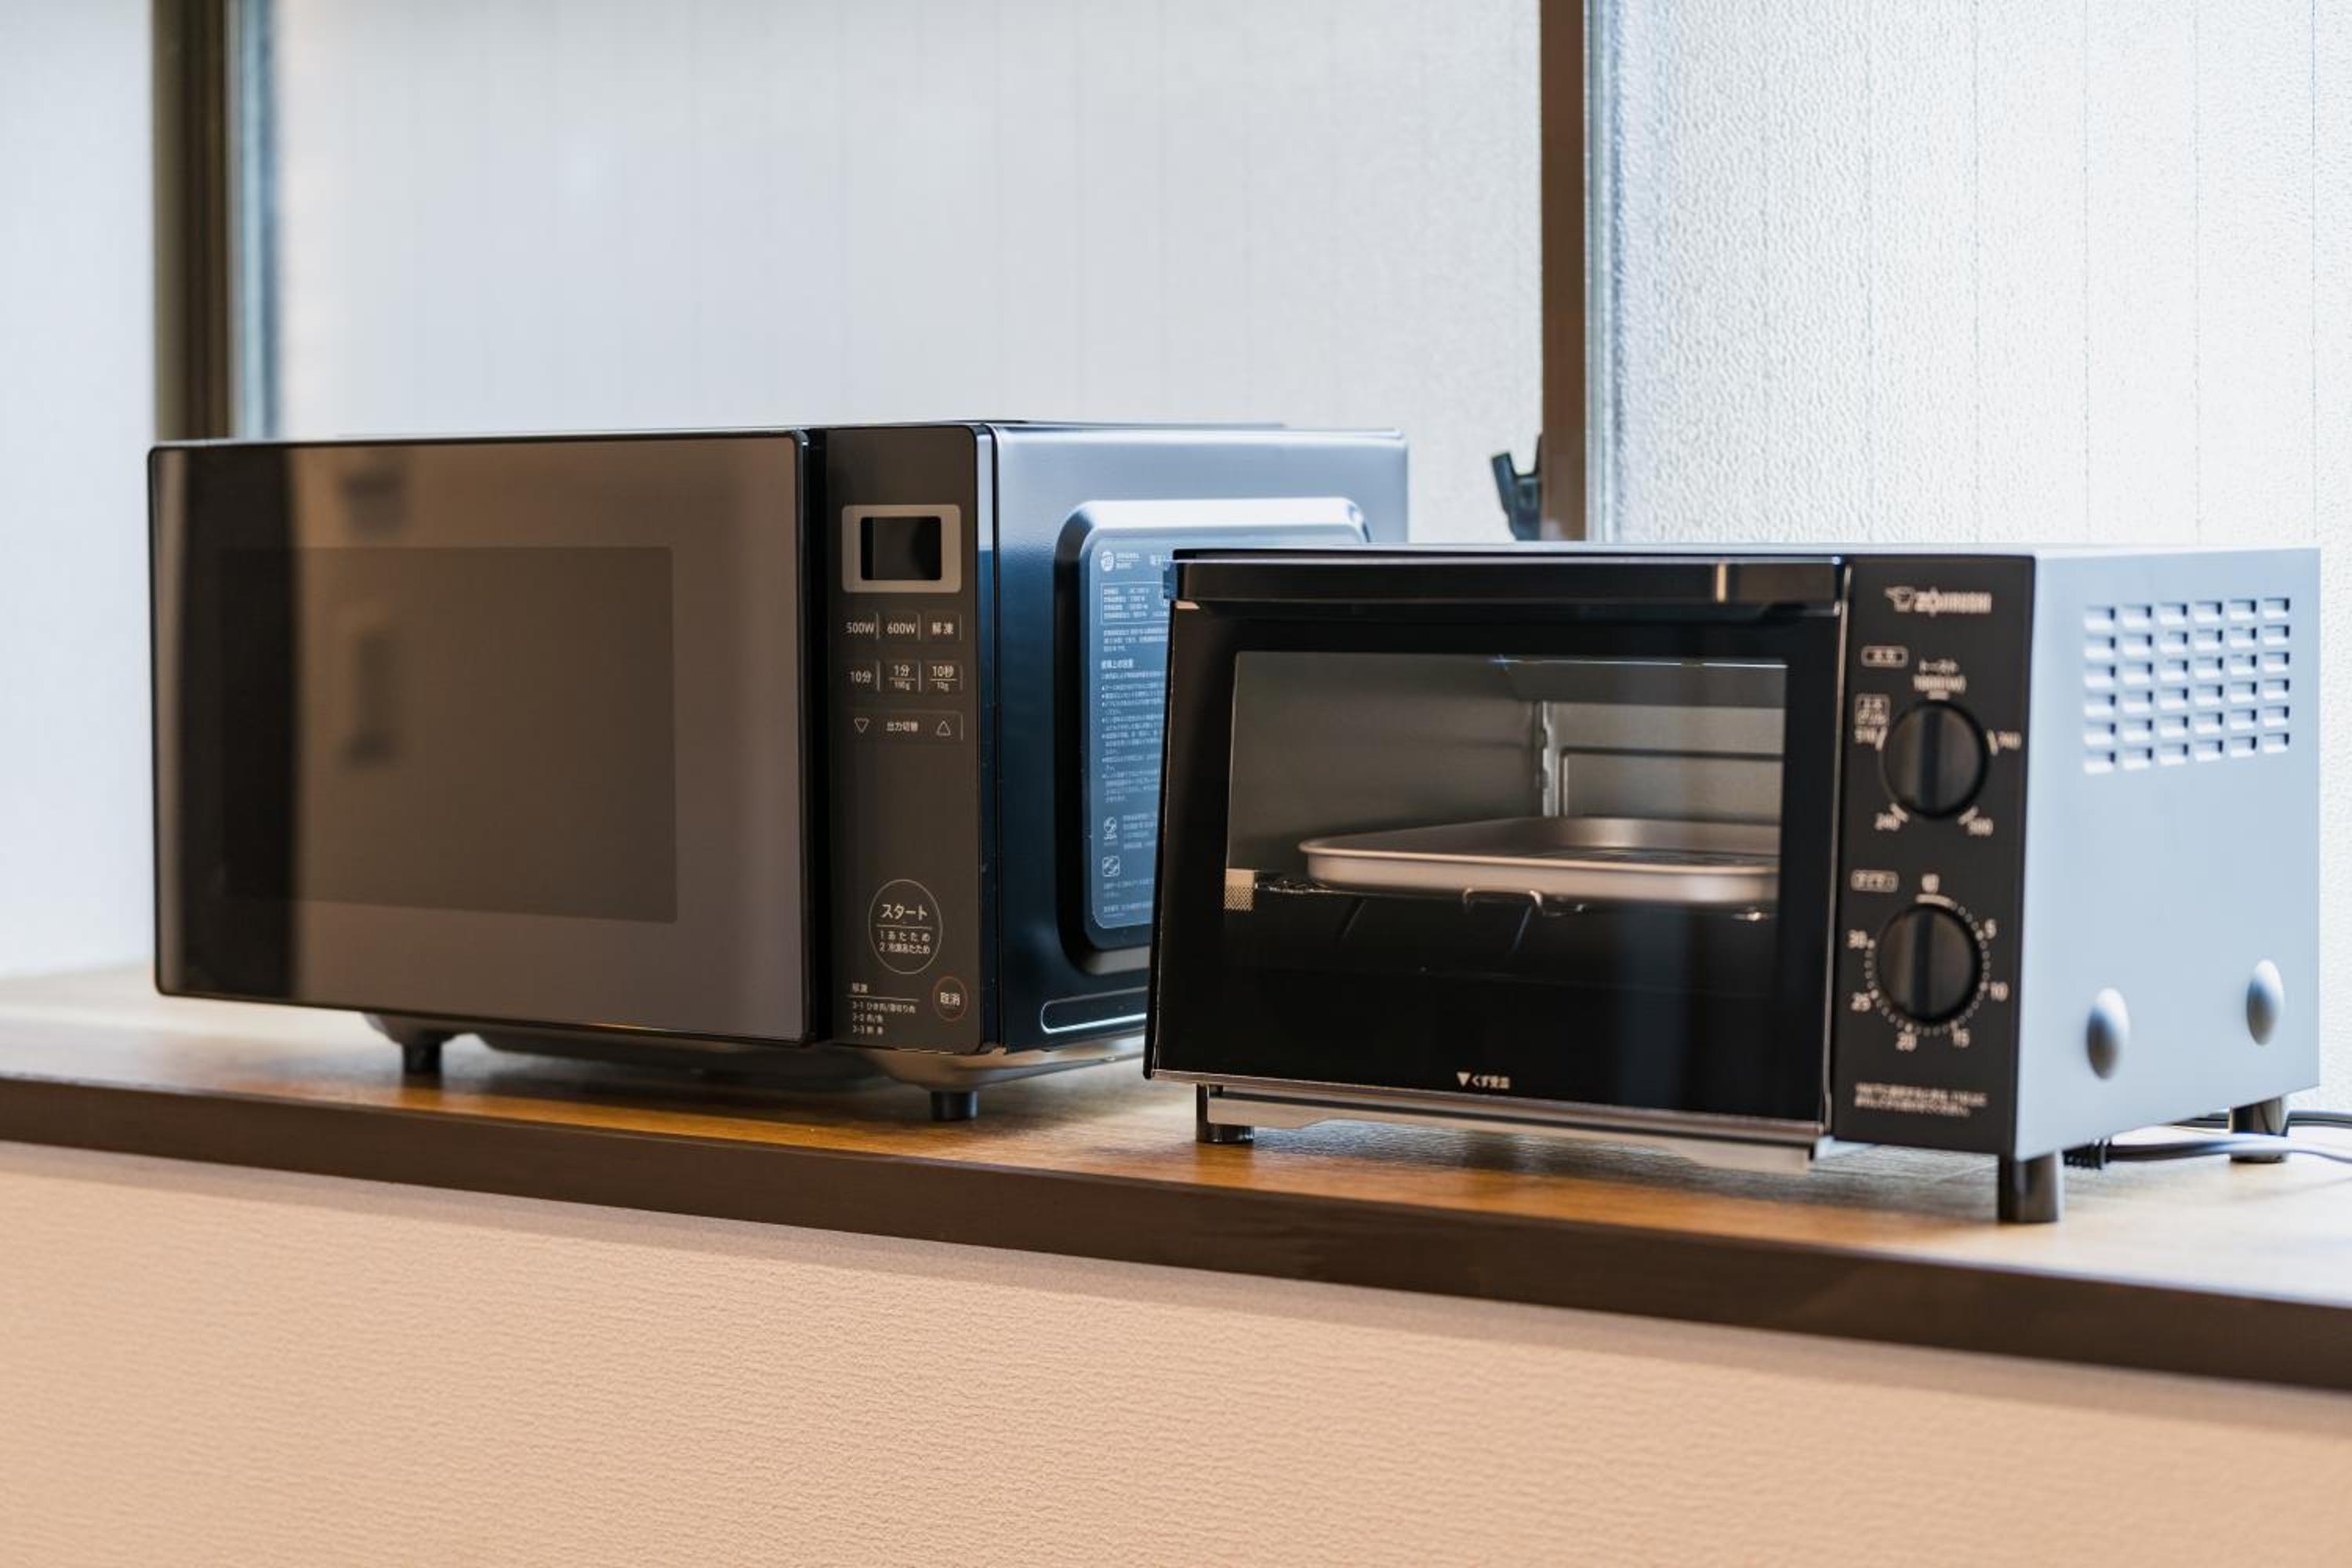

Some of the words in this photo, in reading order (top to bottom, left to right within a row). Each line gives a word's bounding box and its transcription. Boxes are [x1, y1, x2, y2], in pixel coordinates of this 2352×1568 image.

[847, 622, 875, 634] 500W
[887, 622, 916, 634] 600W
[893, 665, 910, 677] 1分
[931, 666, 955, 678] 10秒
[881, 904, 928, 920] スタート
